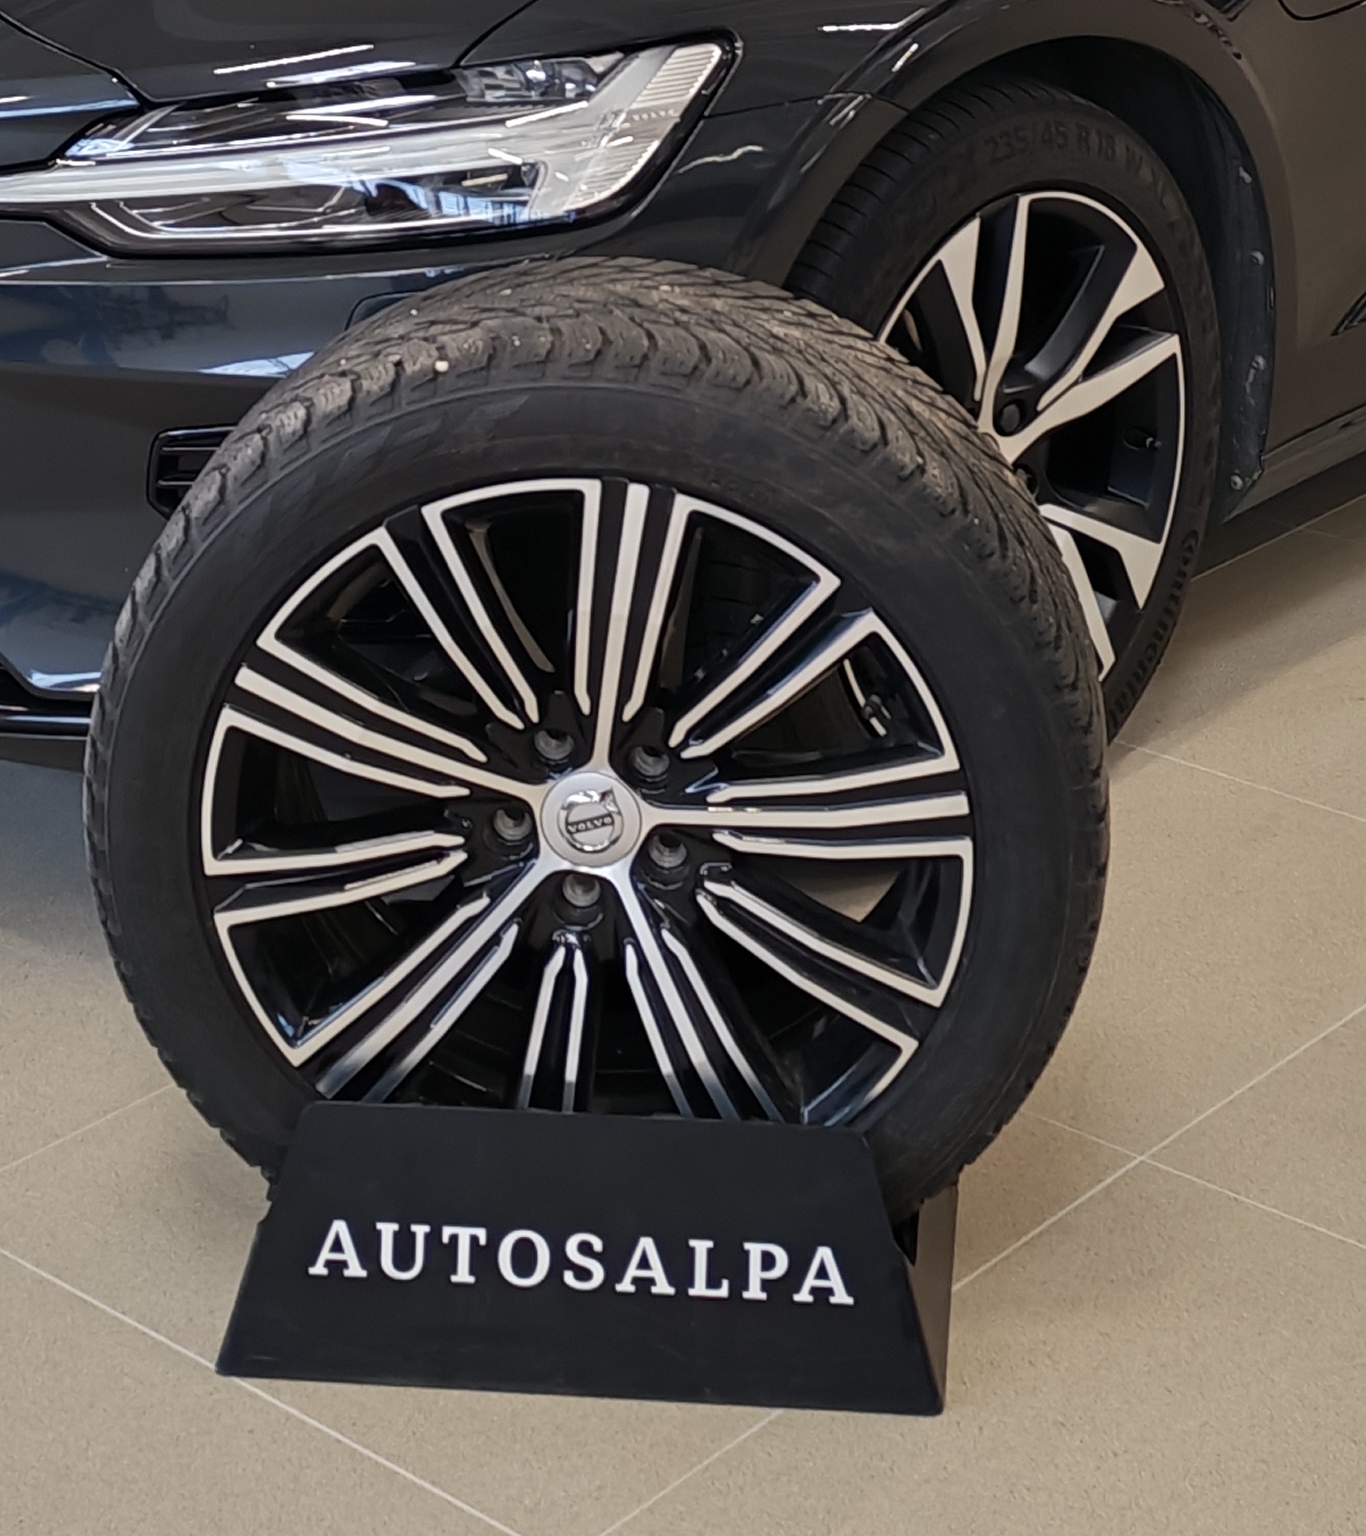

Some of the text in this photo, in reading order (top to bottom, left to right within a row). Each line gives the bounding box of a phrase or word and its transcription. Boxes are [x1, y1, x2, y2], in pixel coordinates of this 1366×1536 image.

[982, 119, 1069, 165] 235/45
[566, 815, 614, 834] VOLVO
[308, 1219, 855, 1306] AUTOSALPA
